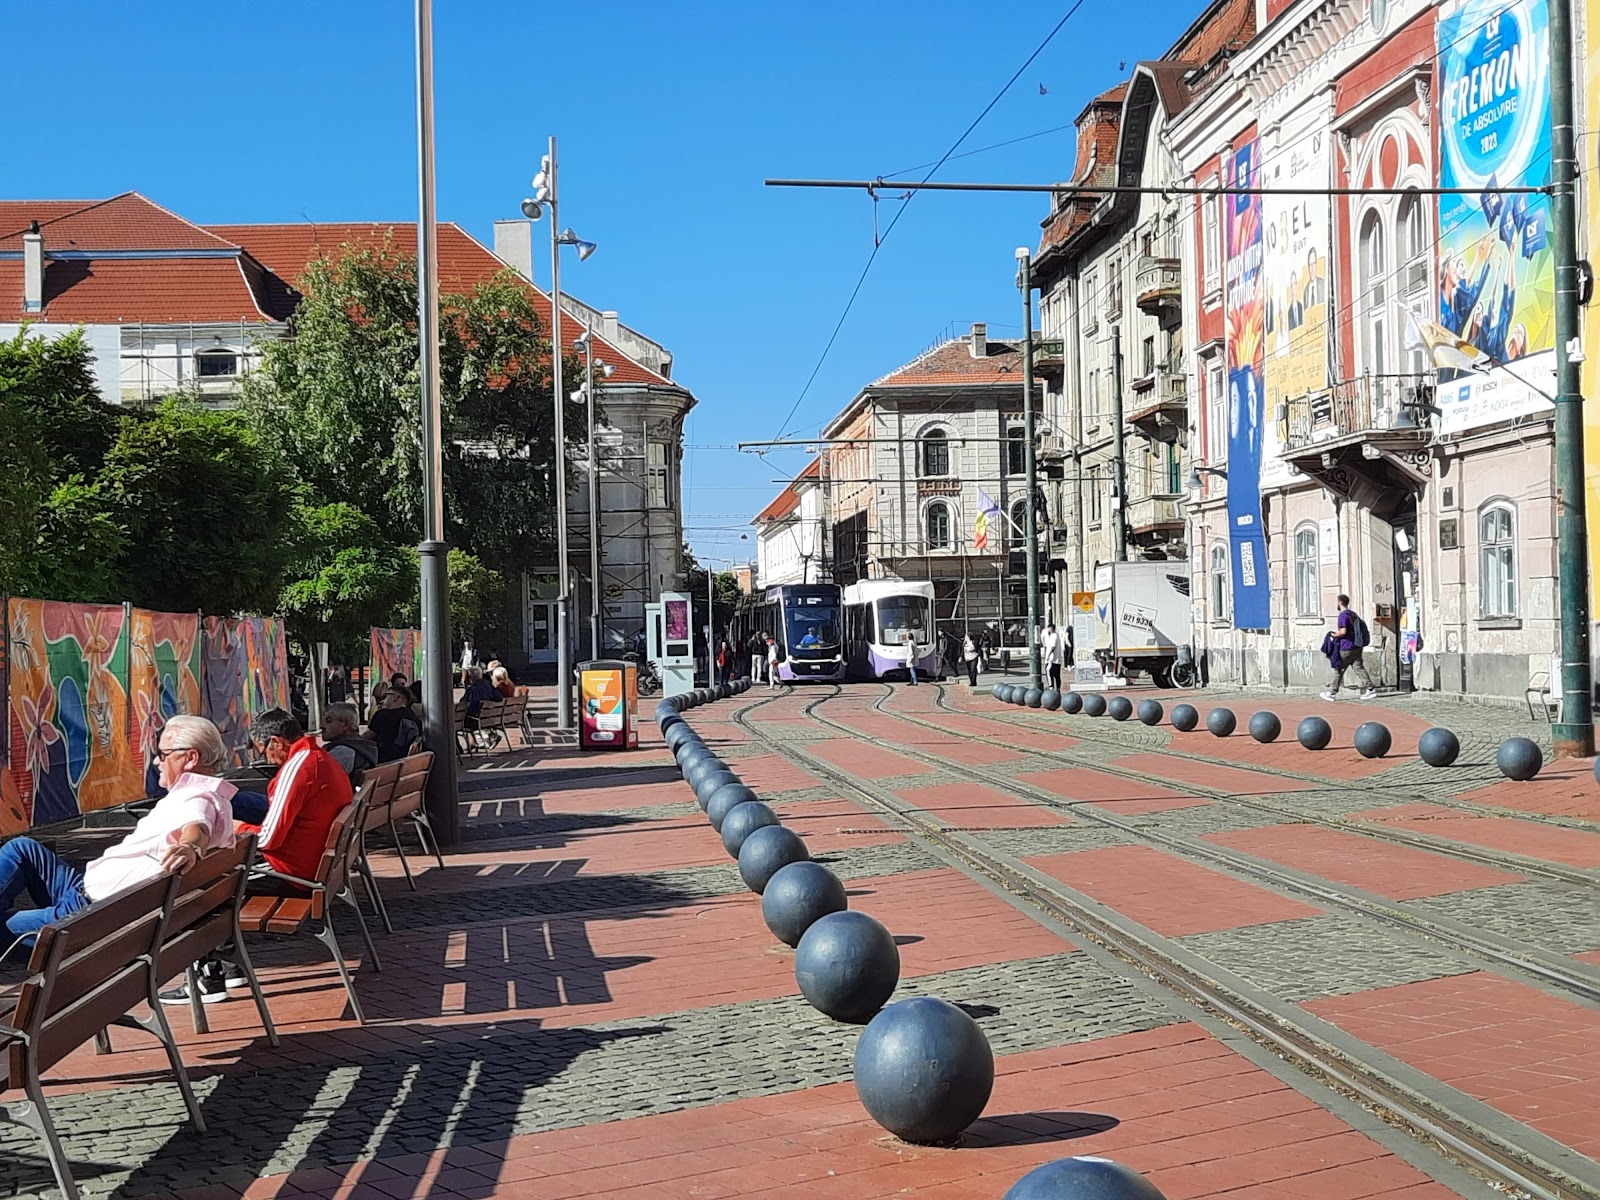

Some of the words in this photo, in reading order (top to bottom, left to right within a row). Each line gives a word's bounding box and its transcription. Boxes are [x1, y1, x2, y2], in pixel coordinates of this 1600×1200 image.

[1461, 121, 1472, 140] DE
[1473, 96, 1518, 134] ABSOLVIRE
[1480, 131, 1498, 155] 2023
[1123, 613, 1135, 623] 021
